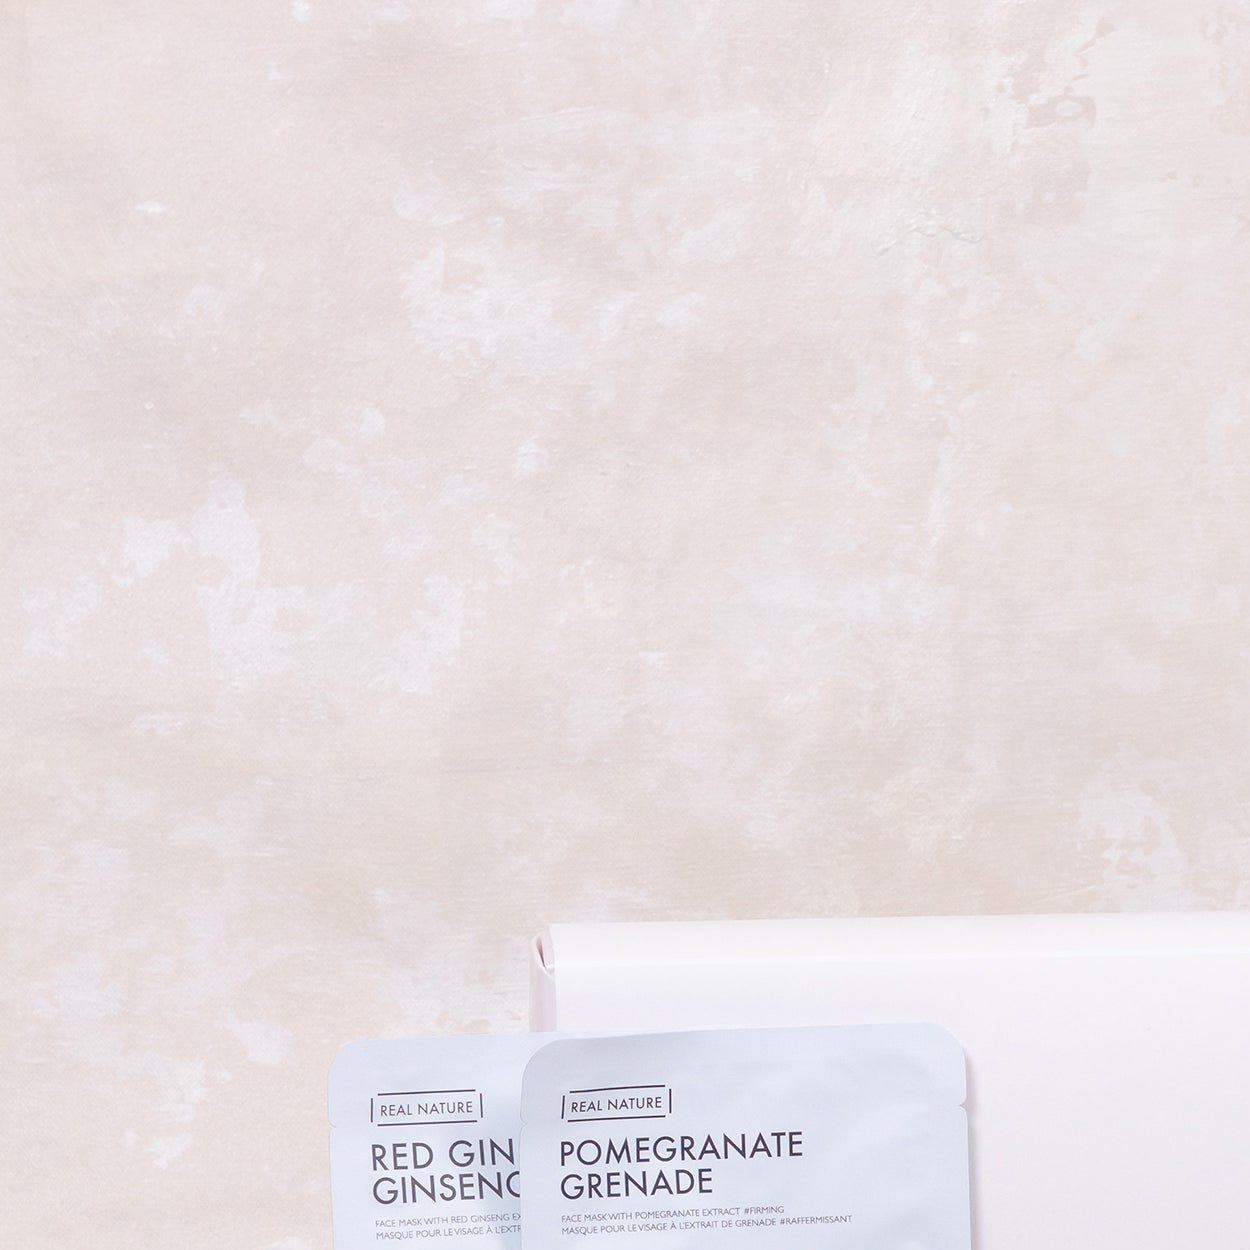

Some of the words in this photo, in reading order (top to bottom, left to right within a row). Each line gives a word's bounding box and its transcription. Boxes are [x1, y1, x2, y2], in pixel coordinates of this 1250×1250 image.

[380, 1103, 412, 1117] REAL
[418, 1101, 473, 1115] NATURE
[571, 1100, 603, 1113] REAL
[607, 1096, 662, 1110] NATURE
[371, 1142, 434, 1171] RED
[560, 1131, 803, 1167] POMEGRANATE
[560, 1168, 713, 1200] GRENADE
[375, 1219, 397, 1228] FACE
[399, 1217, 423, 1227] MASK
[423, 1216, 449, 1226] WITH
[451, 1215, 468, 1224] RED
[470, 1213, 511, 1223] GINSENG
[561, 1214, 582, 1223] FACE
[583, 1213, 608, 1222] MASK
[608, 1212, 633, 1221] WITH
[635, 1208, 700, 1220] POMEGRANATE
[702, 1207, 741, 1216] EXTRACT
[743, 1205, 785, 1215] #FIRMING
[376, 1230, 414, 1240] MASQUE
[416, 1229, 442, 1238] POUR
[443, 1228, 453, 1237] LE
[454, 1226, 484, 1236] VISAGE
[561, 1226, 598, 1236] MASQUE
[600, 1224, 626, 1233] POUR
[627, 1224, 637, 1233] LE
[638, 1222, 668, 1232] VISAGE
[670, 1220, 677, 1230] À
[679, 1220, 719, 1230] L'EXTRAIT
[721, 1219, 733, 1228] DE
[735, 1218, 777, 1228] GRENADE
[780, 1214, 853, 1226] #RAFFERMISSANT
